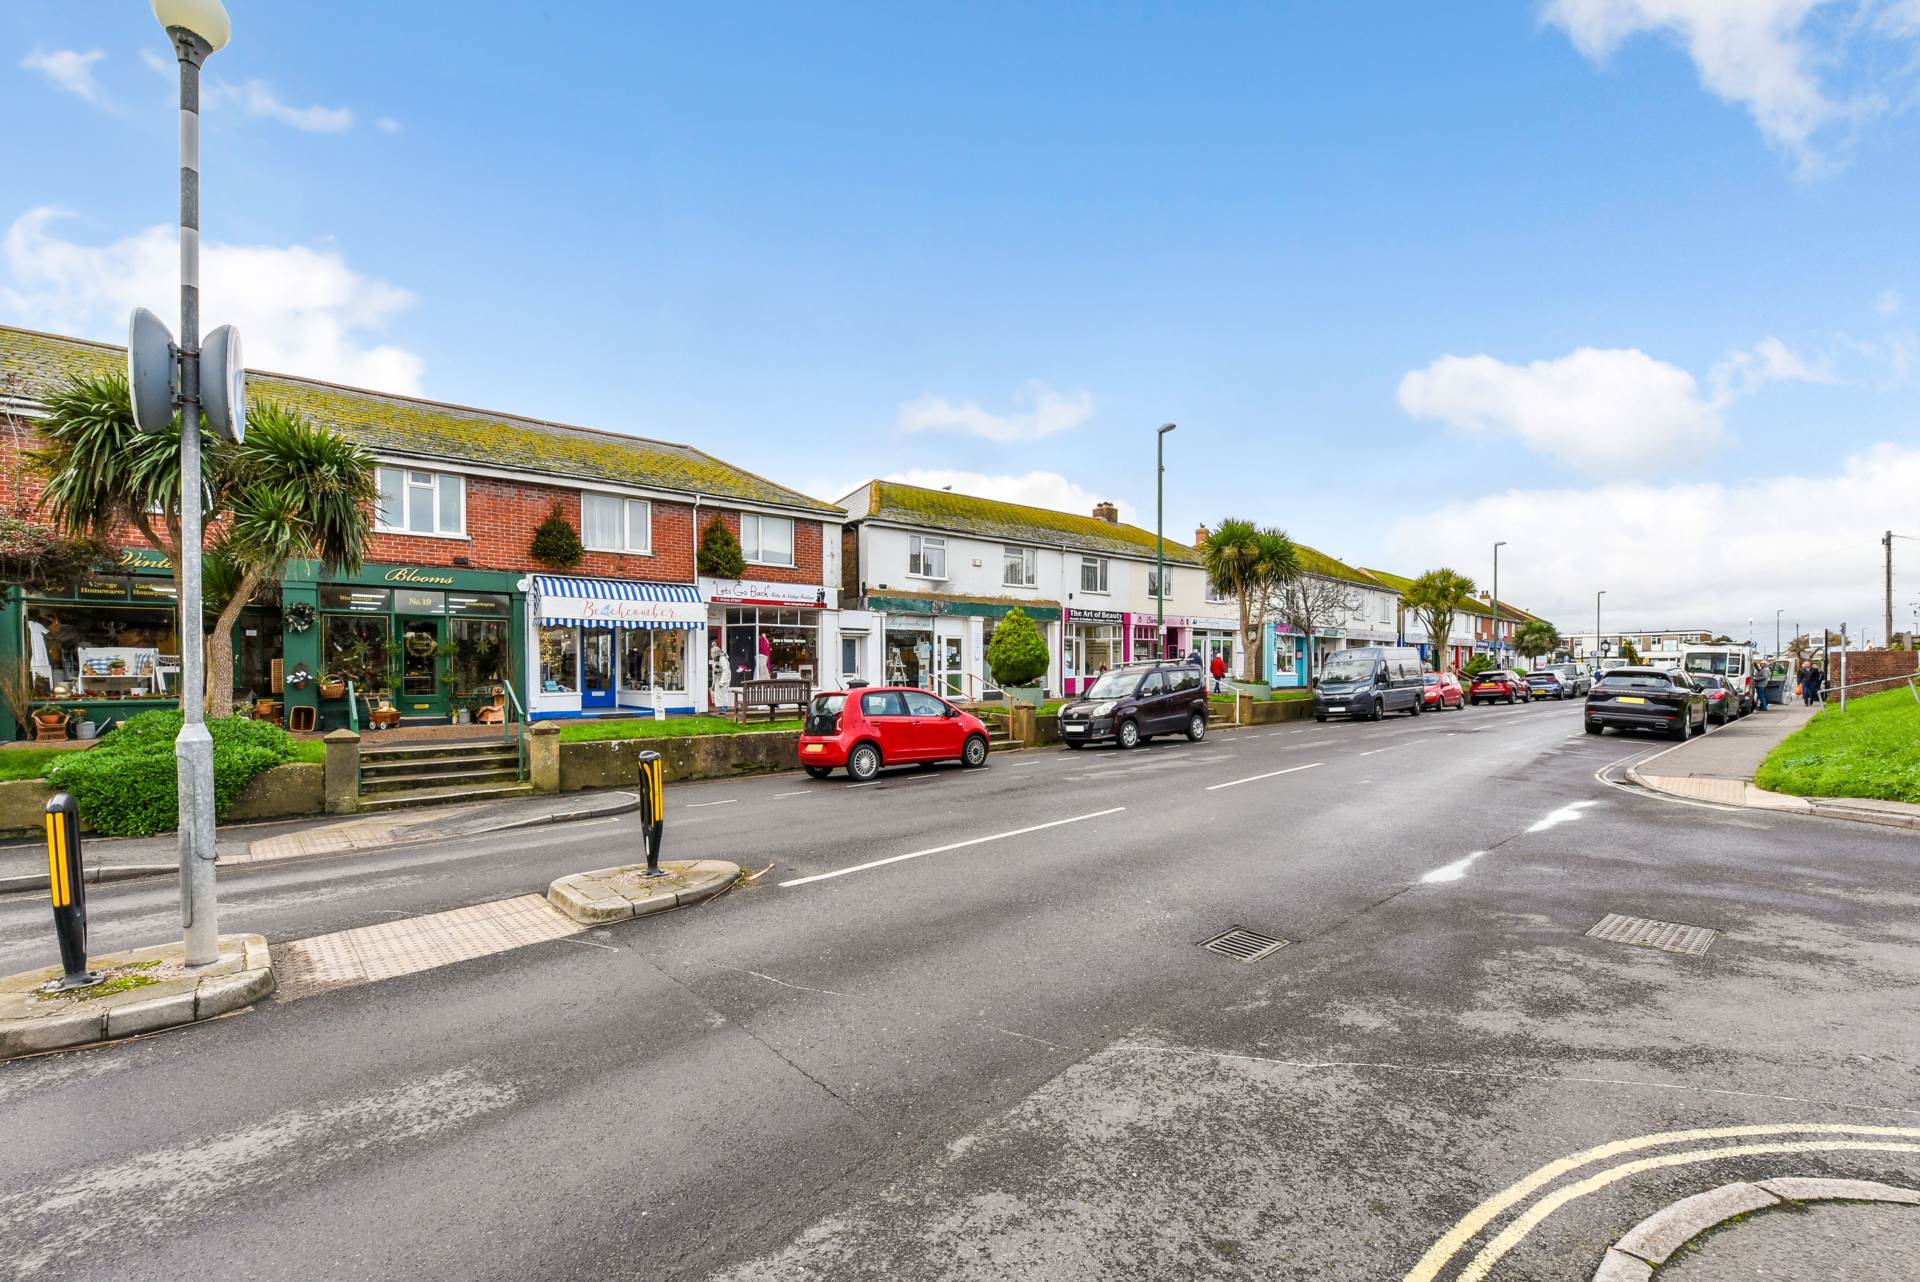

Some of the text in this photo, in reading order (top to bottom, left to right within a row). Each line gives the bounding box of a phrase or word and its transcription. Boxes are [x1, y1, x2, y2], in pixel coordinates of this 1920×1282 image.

[119, 550, 173, 568] Vinta
[384, 568, 455, 585] Blooms
[80, 586, 125, 595] Homewares
[733, 583, 748, 597] Go
[1083, 610, 1094, 618] Art
[1102, 612, 1122, 620] Beauty
